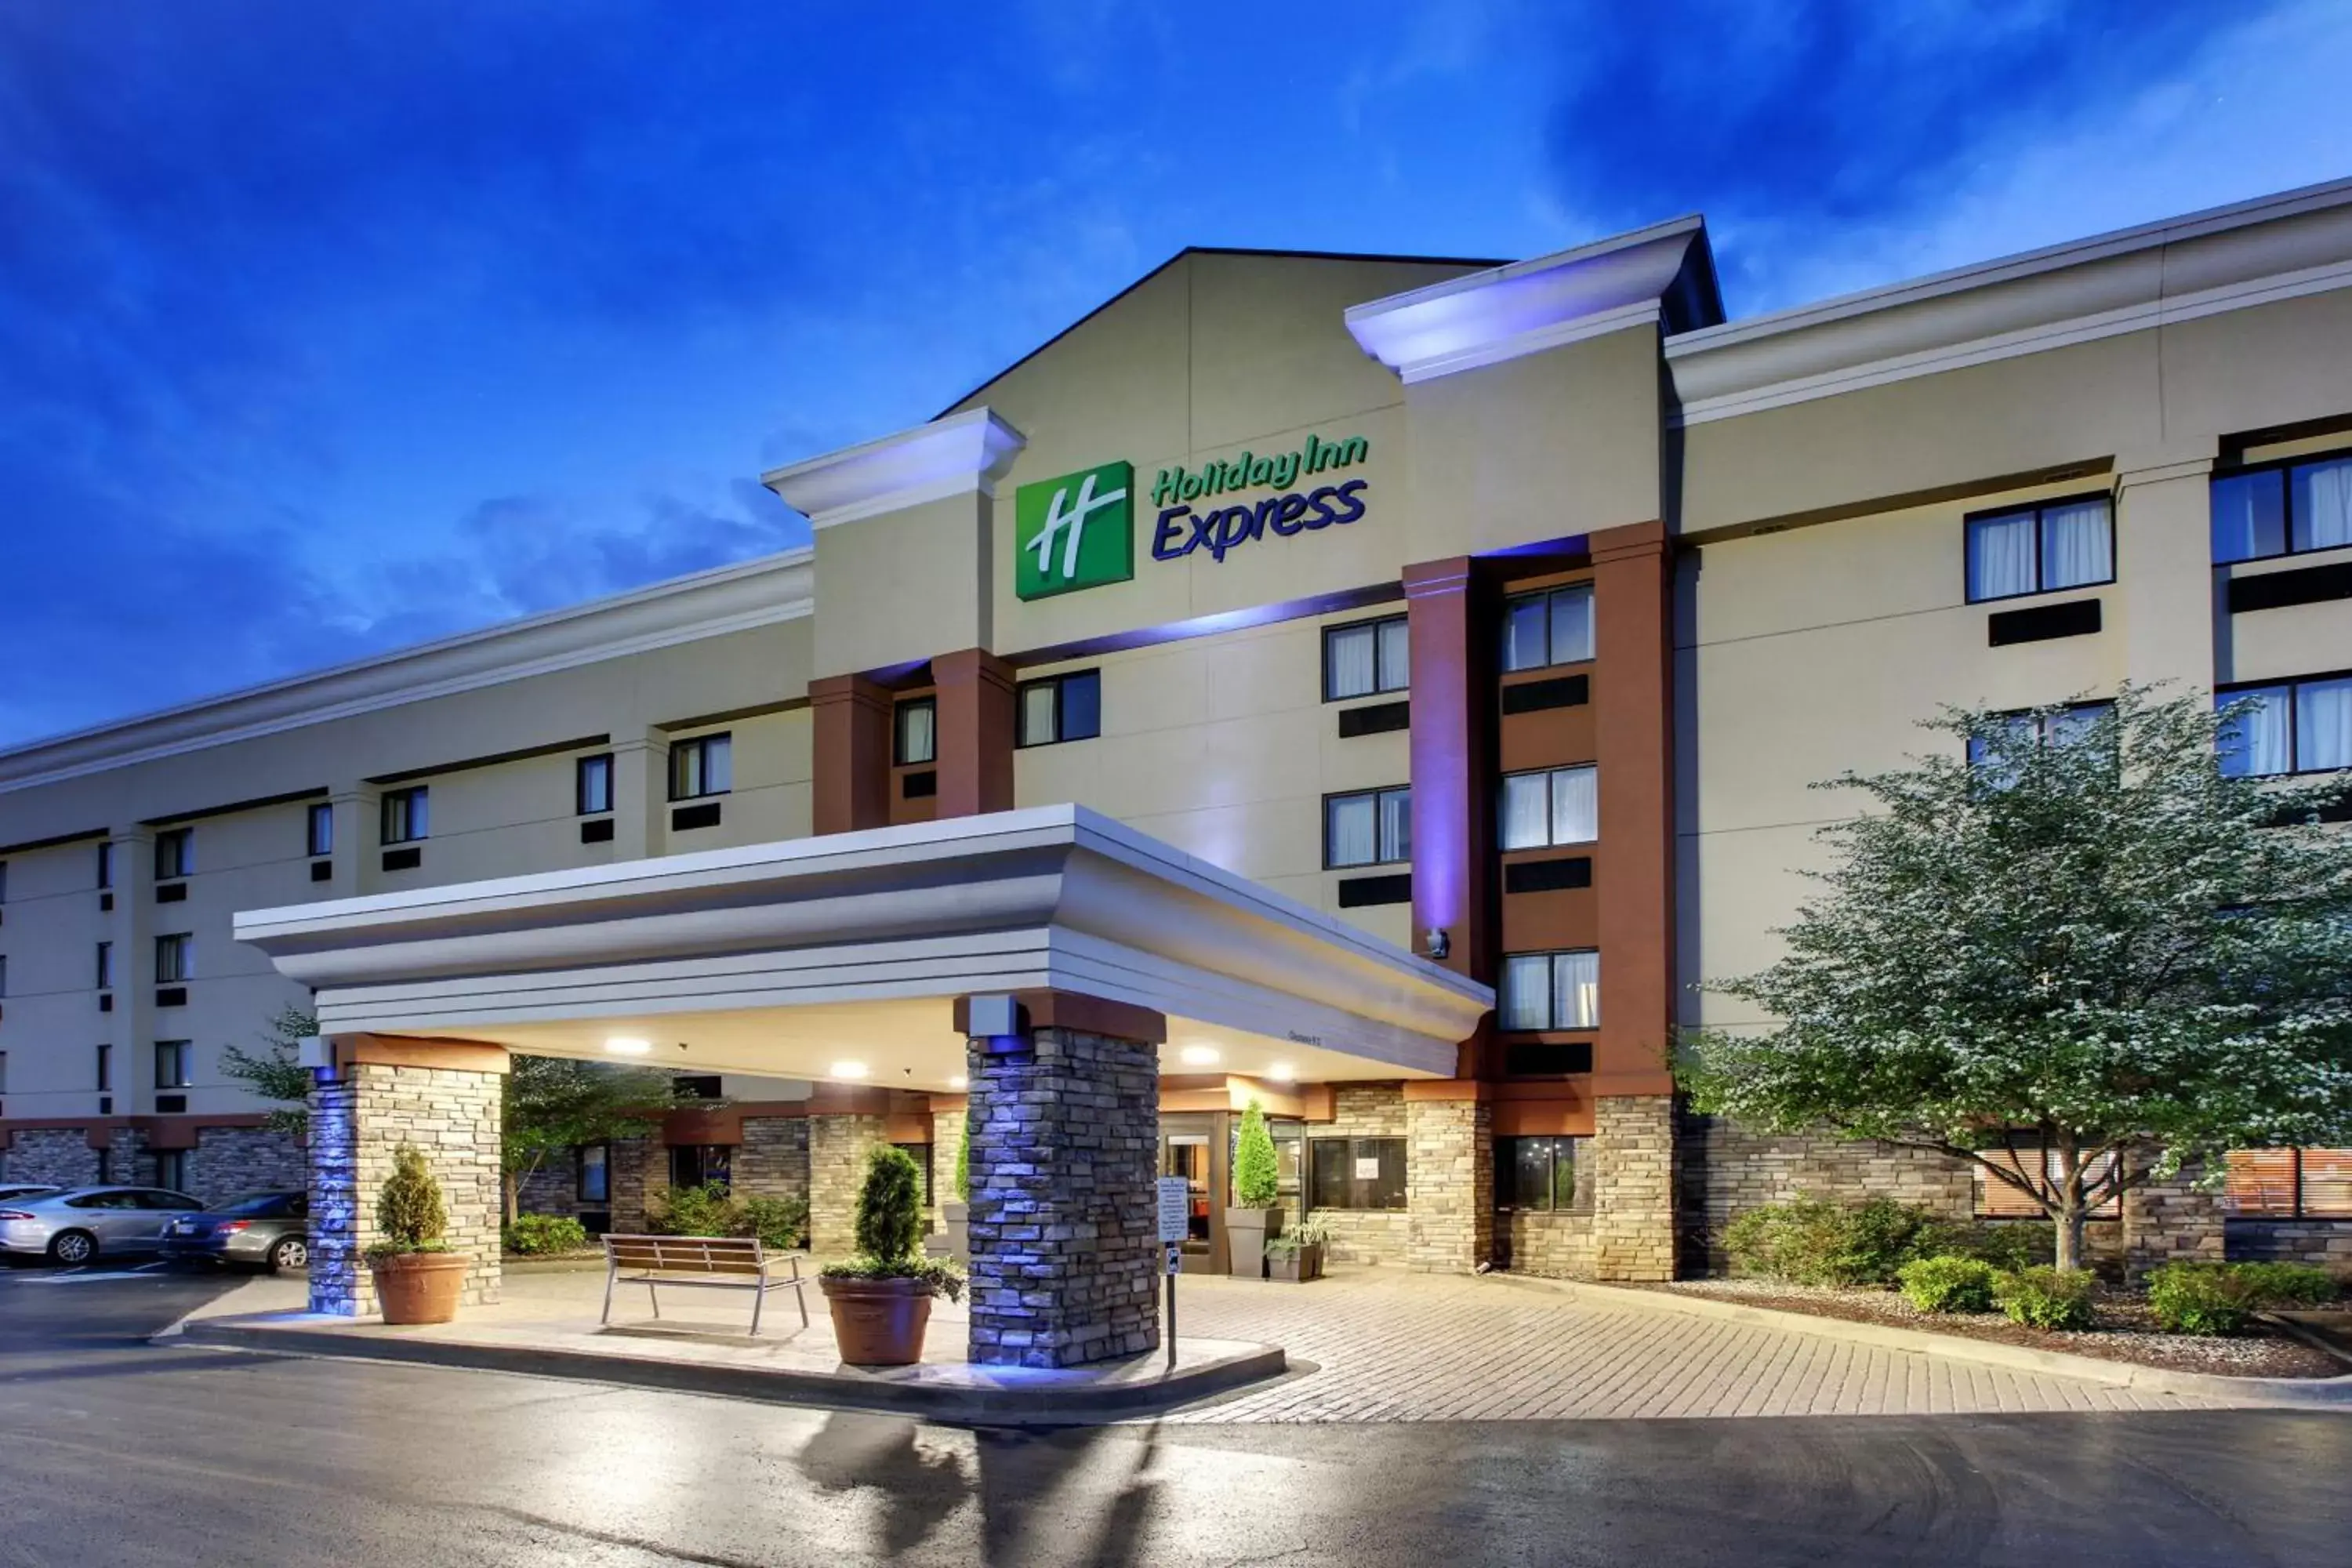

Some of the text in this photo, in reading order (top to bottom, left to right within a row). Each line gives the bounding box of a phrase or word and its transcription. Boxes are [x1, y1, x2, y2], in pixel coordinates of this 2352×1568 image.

[1151, 434, 1368, 507] Holiday Inn
[1152, 479, 1368, 563] Express
